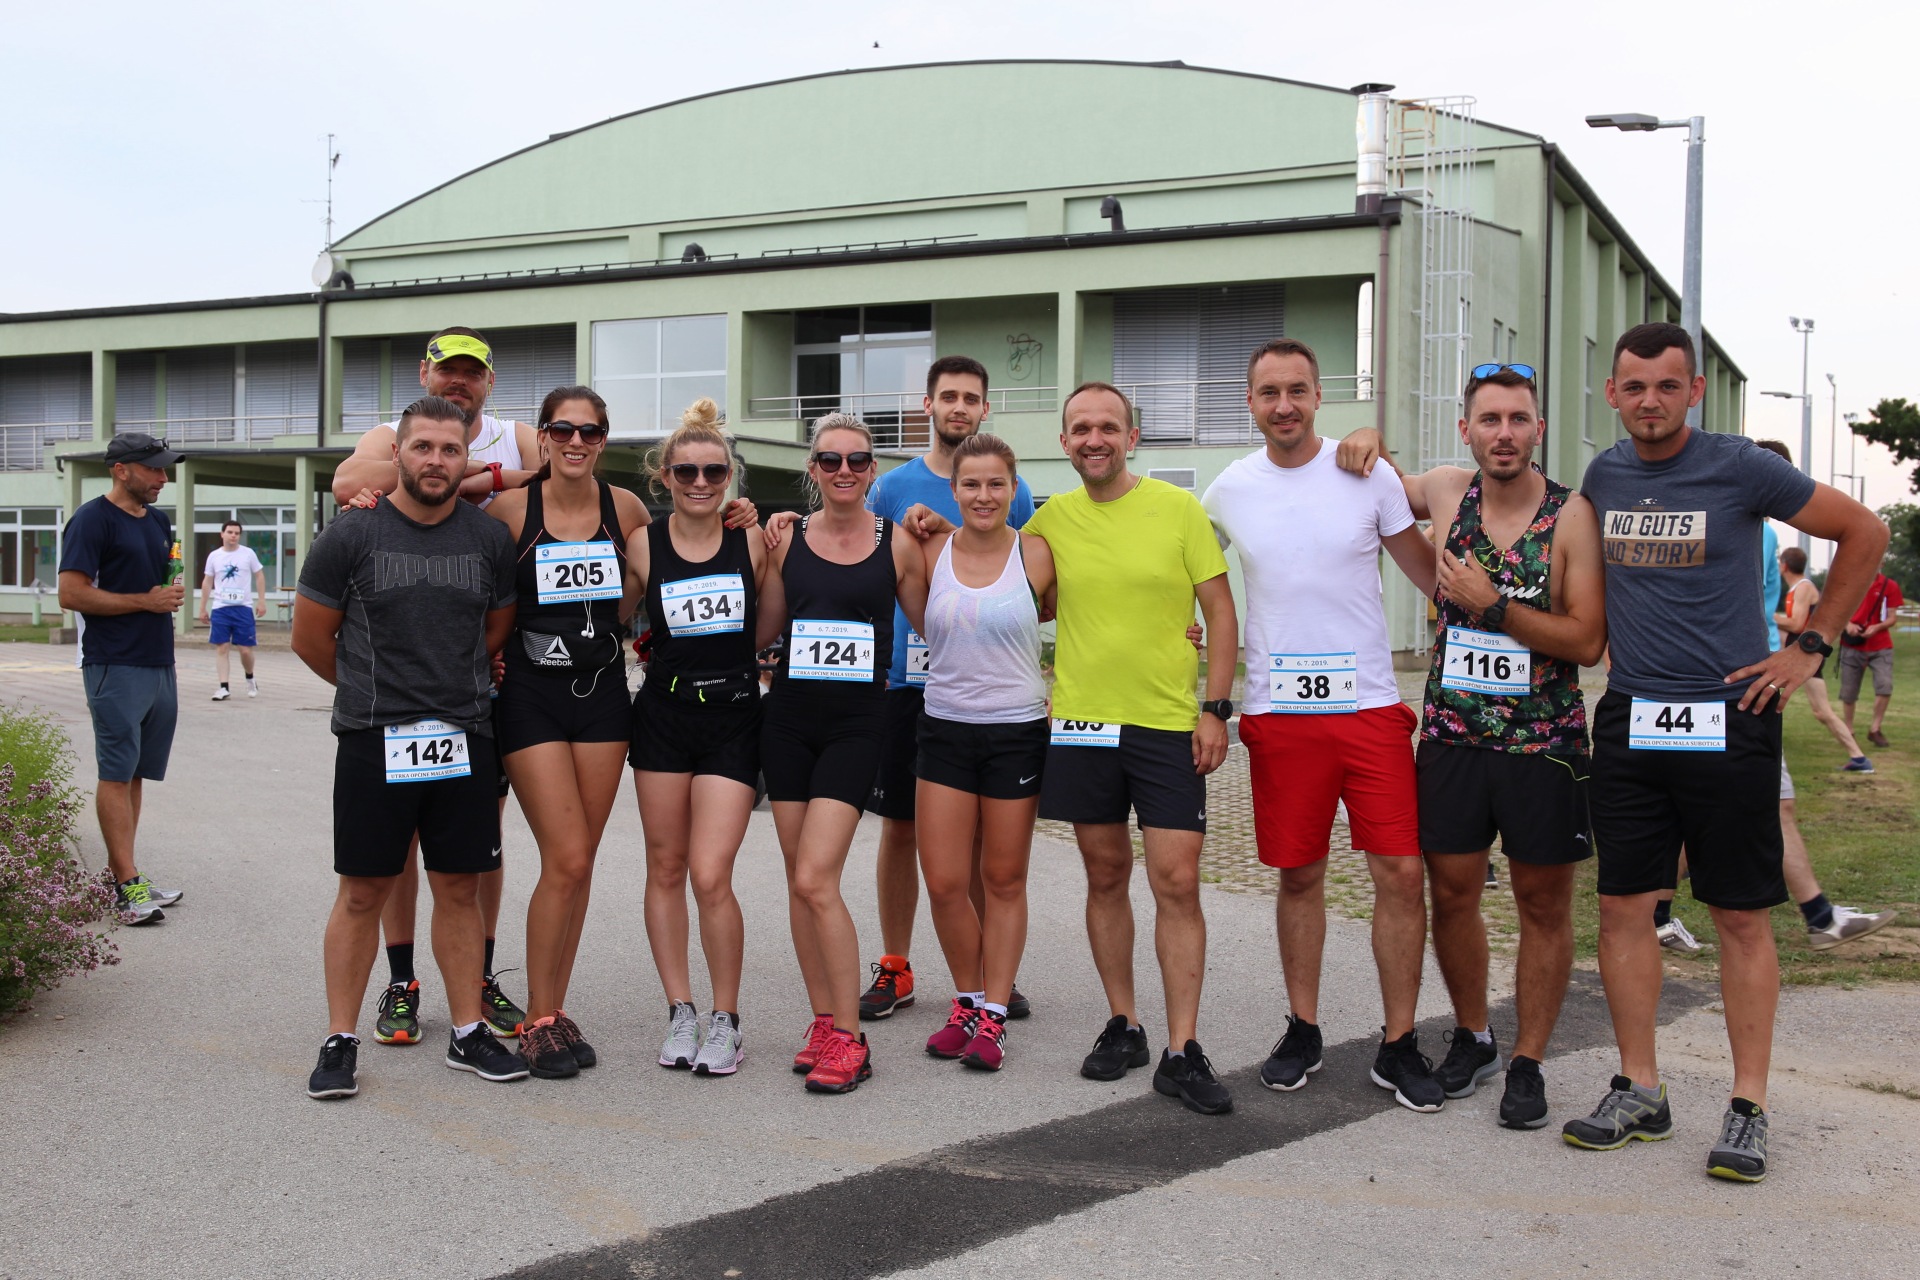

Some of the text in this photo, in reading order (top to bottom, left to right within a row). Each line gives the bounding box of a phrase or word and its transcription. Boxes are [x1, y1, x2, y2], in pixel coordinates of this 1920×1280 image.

[1610, 514, 1694, 536] NO GUTS
[1607, 541, 1700, 564] NO STORY
[370, 550, 483, 594] TAPOUT
[555, 562, 605, 588] 205
[682, 595, 731, 622] 134
[809, 641, 857, 665] 124
[1484, 638, 1501, 646] 2019.
[540, 657, 573, 666] Reebok
[1463, 651, 1511, 680] 116
[1297, 675, 1330, 700] 38
[1656, 706, 1694, 732] 44
[406, 739, 454, 766] 142
